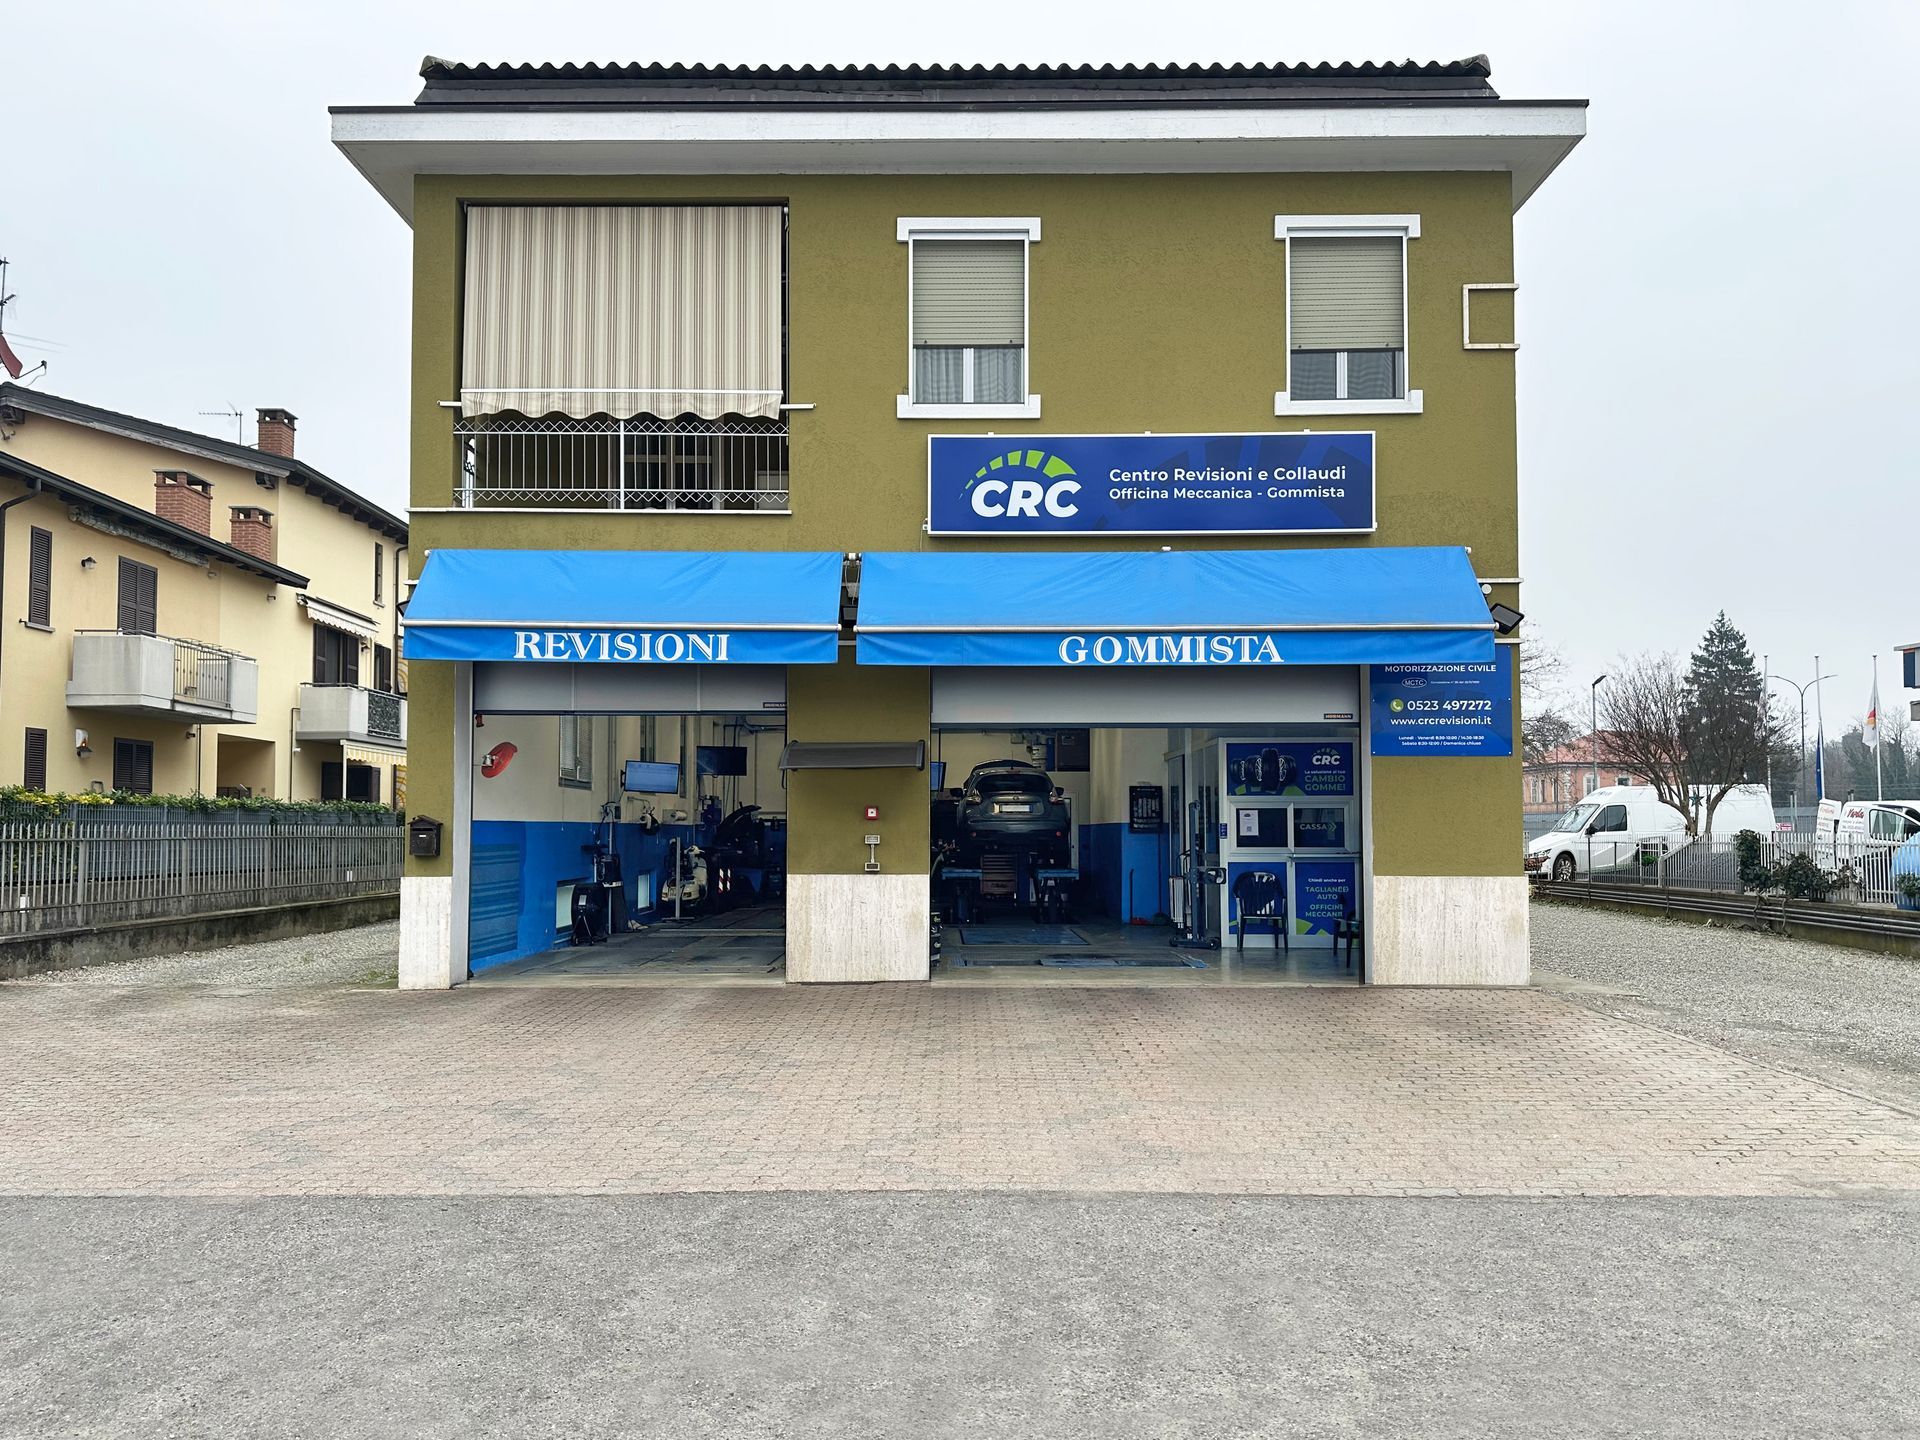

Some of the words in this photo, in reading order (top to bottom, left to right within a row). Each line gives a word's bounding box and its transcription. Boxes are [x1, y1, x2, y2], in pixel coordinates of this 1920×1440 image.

[1109, 468, 1169, 482] Centro
[1174, 467, 1252, 482] Revisioni
[1258, 470, 1269, 481] e
[1273, 466, 1347, 481] Collaudi
[1109, 487, 1169, 500] Officina
[1173, 487, 1252, 500] Meccanica
[1267, 486, 1345, 499] Gommista
[971, 480, 1083, 518] CRC
[513, 631, 730, 661] REVISIONI
[1058, 635, 1284, 664] GOMMISTA
[1384, 665, 1466, 673] MOTORIZZAZIONE
[1468, 664, 1497, 672] CIVILE
[1404, 679, 1424, 687] MCTC
[1407, 700, 1439, 711] 0523
[1443, 700, 1492, 711] 497272
[1390, 715, 1492, 726] www.crcrevisioni.it
[1312, 755, 1341, 765] CRC
[1304, 775, 1345, 783] CAMBIO
[1299, 823, 1327, 831] CASSA
